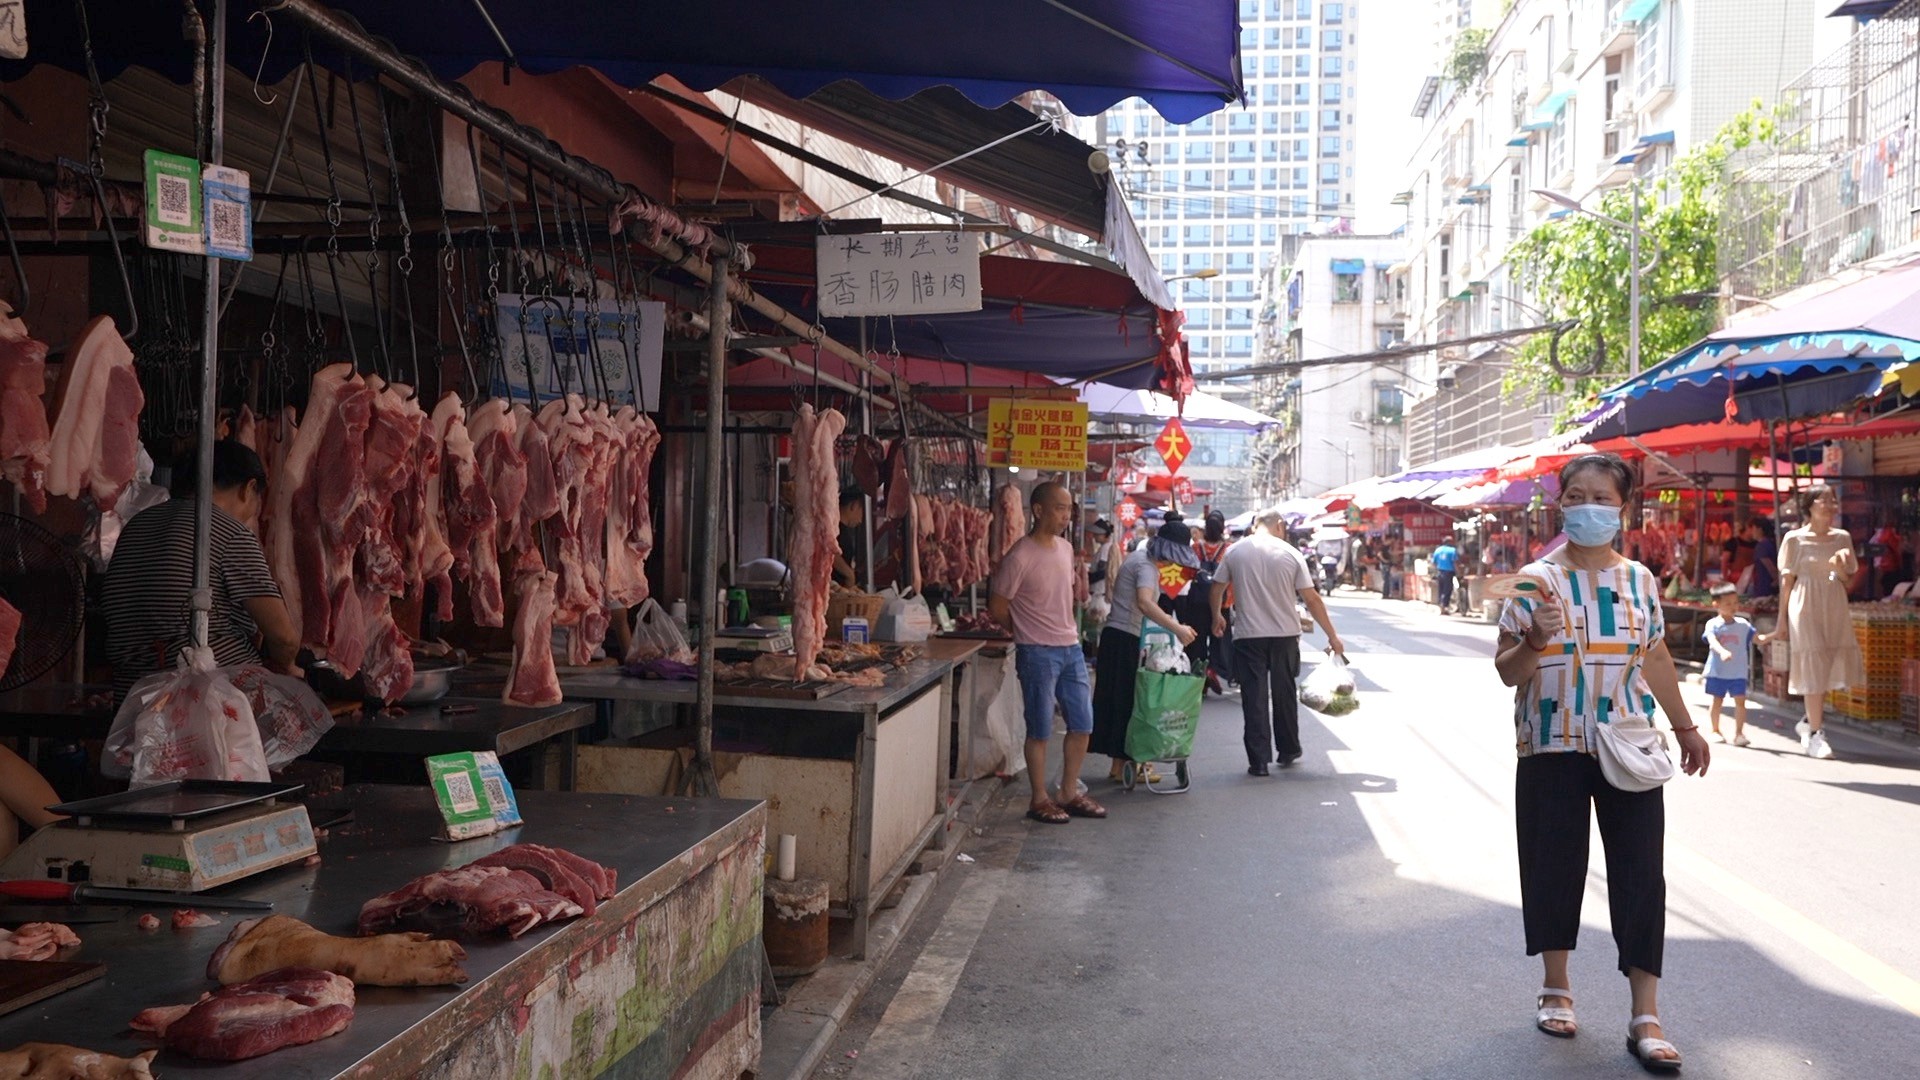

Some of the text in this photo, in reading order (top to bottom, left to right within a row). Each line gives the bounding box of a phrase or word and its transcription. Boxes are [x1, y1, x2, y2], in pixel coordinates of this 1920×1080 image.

[840, 235, 960, 261] 长期出售
[824, 269, 967, 306] 香肠腊肉
[1163, 428, 1183, 461] 大
